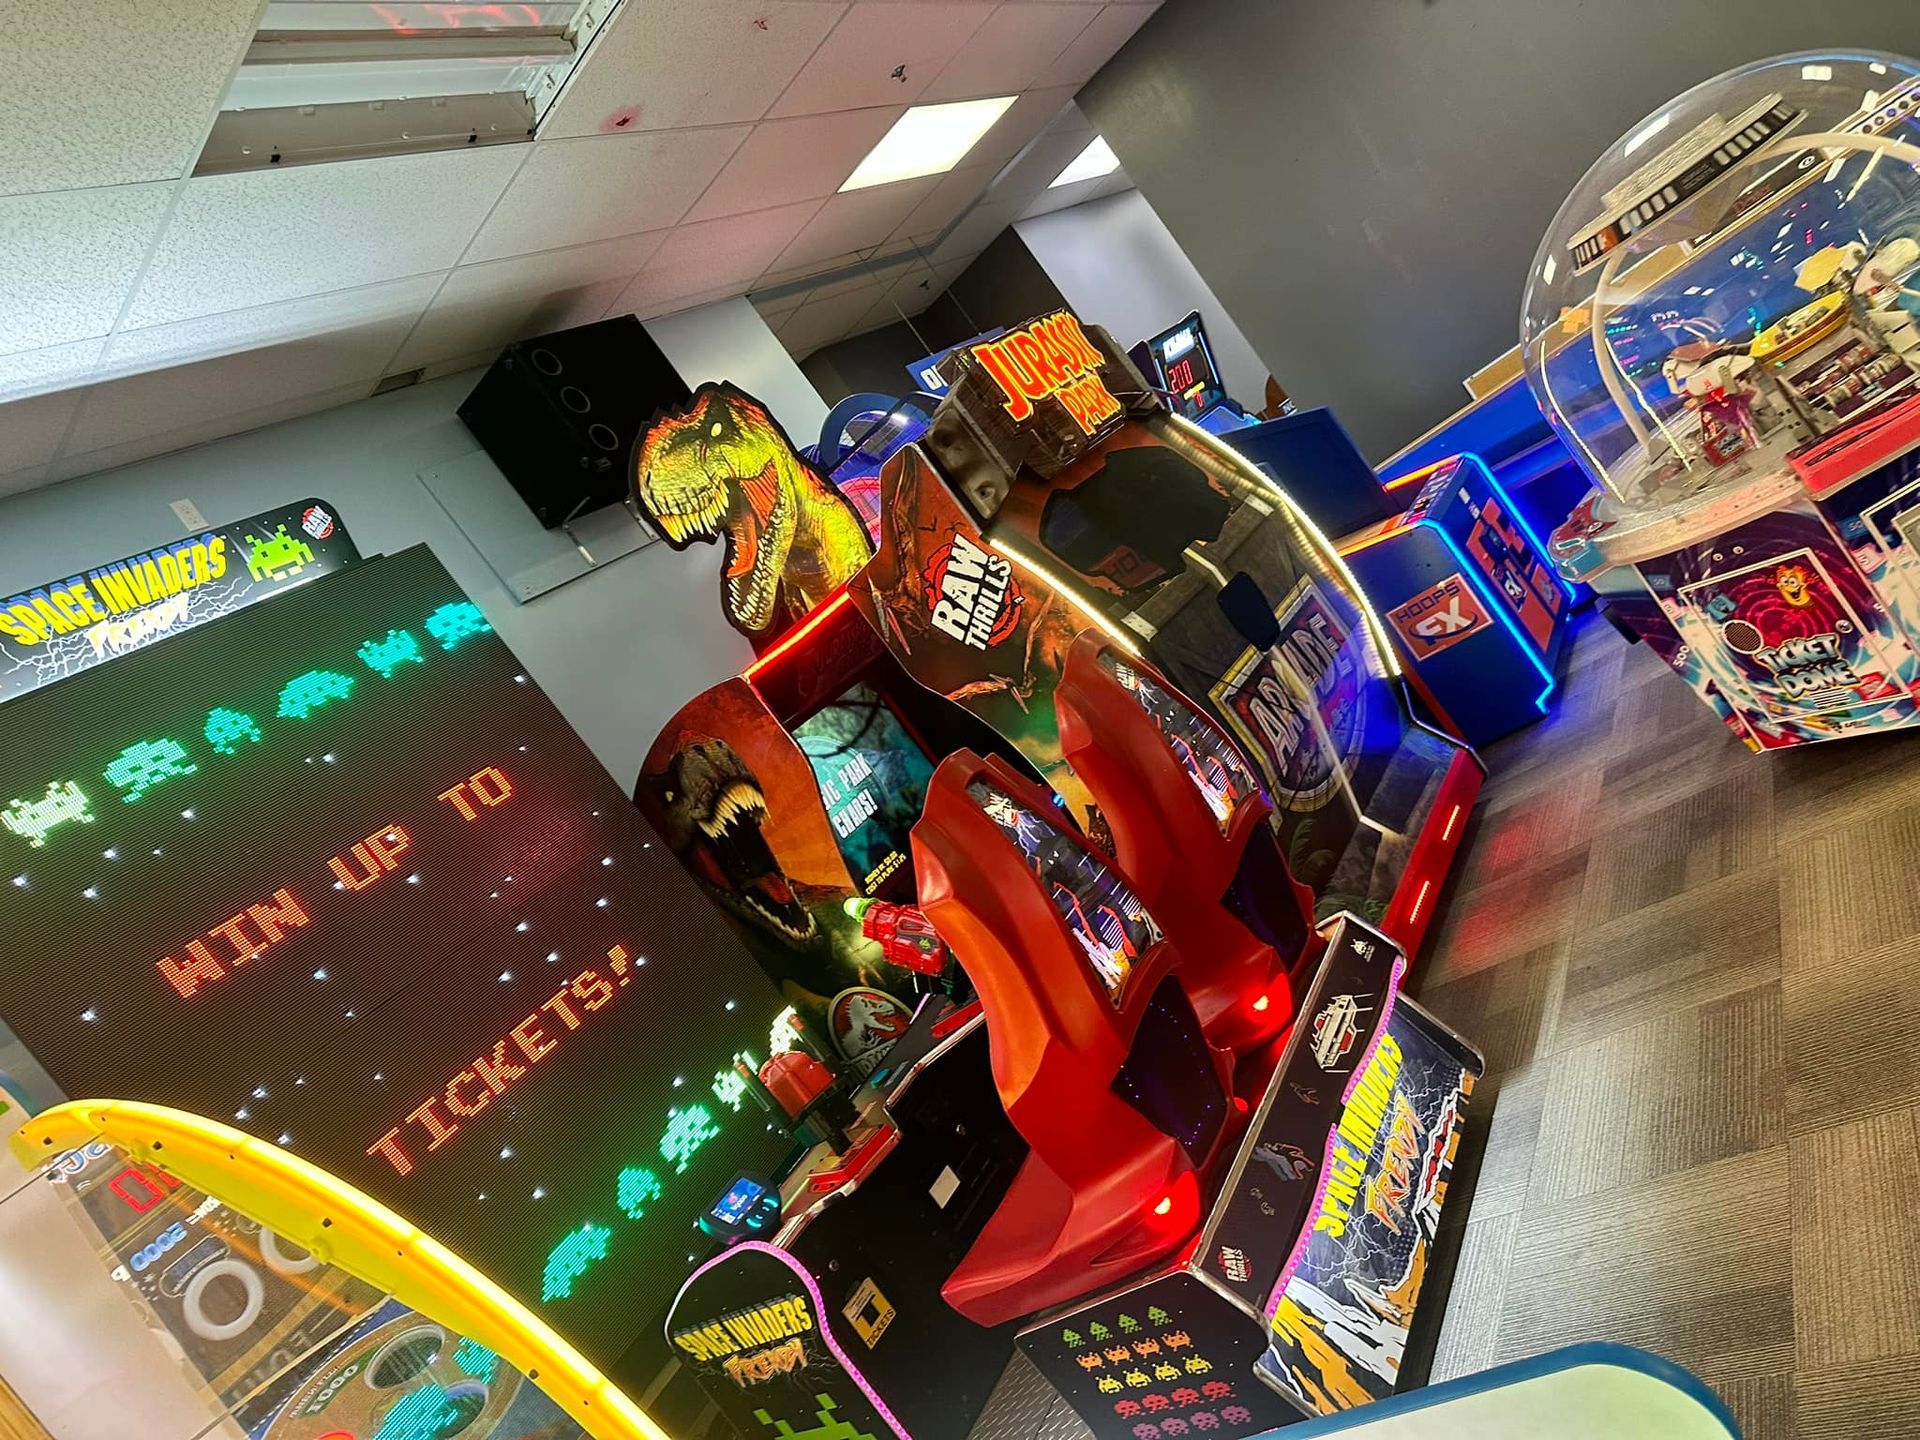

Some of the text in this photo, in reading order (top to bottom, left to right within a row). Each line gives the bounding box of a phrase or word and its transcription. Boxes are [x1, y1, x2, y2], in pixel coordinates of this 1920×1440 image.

[971, 312, 1105, 421] JURASSIC
[1168, 360, 1193, 394] 200
[1053, 374, 1121, 436] PARK
[0, 537, 227, 645] SPACE INVADERS
[932, 534, 989, 640] RAW
[964, 553, 1012, 650] THRILLS
[1398, 580, 1460, 624] HOOPS
[1672, 645, 1690, 668] 500
[1758, 635, 1836, 672] TICKET
[1780, 662, 1857, 699] DOME
[438, 766, 514, 821] TO
[837, 753, 872, 791] PARK
[832, 788, 878, 839] CHAOS!
[328, 825, 411, 891] UP
[156, 888, 310, 999] WIN
[366, 945, 631, 1176] TICKETS!
[1314, 1033, 1404, 1239] SPACE INVADERS
[674, 1319, 740, 1362] SPACE
[721, 1295, 813, 1352] INVADERS
[867, 1308, 894, 1346] TICKETS
[722, 1339, 807, 1387] FRENZY
